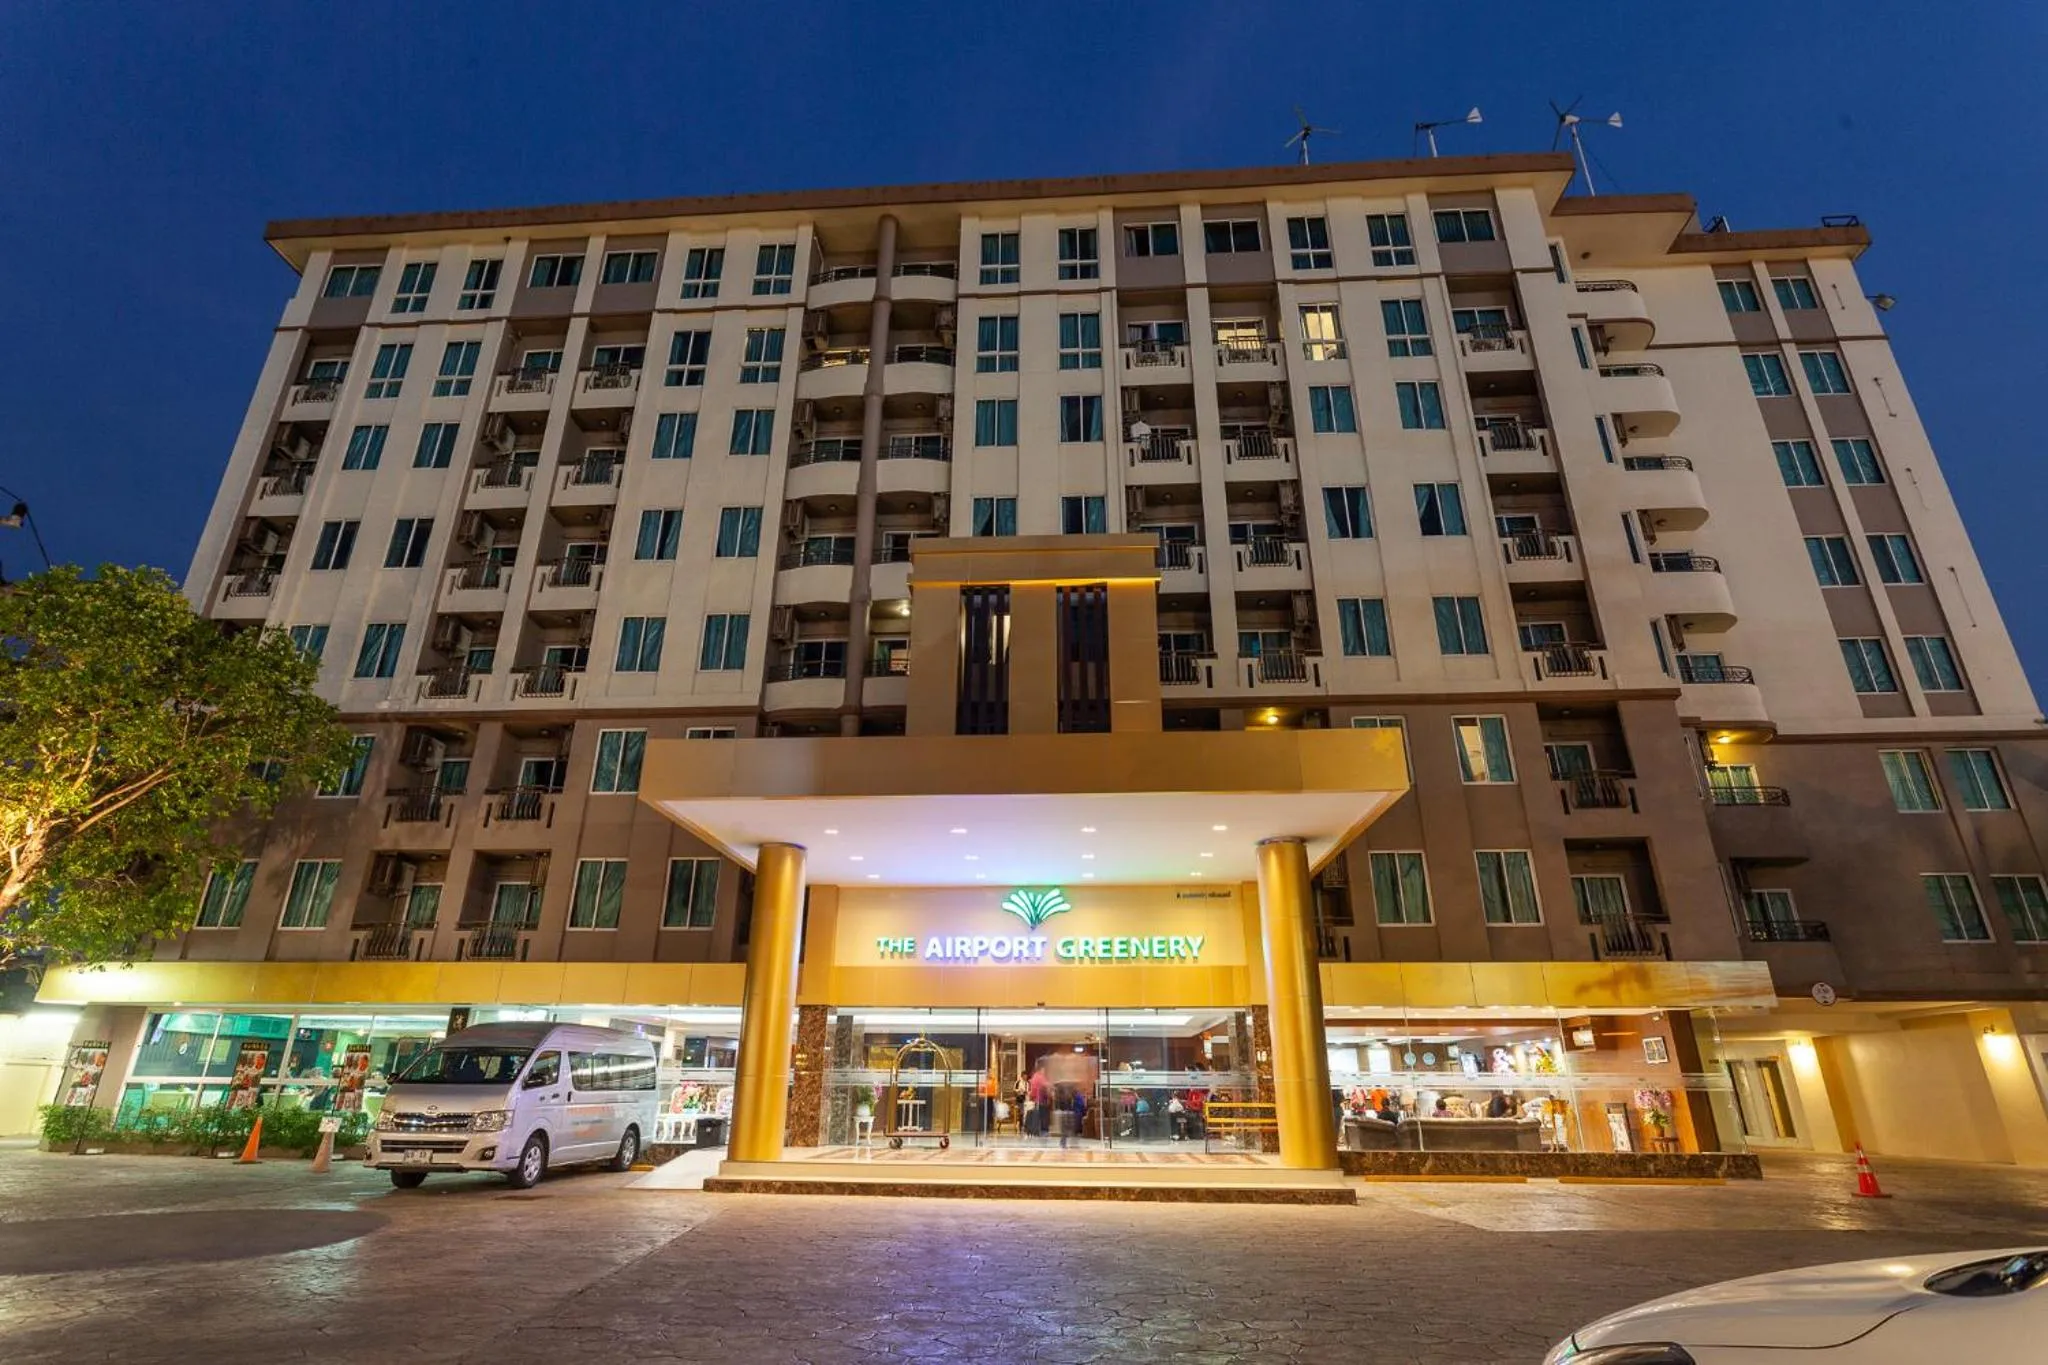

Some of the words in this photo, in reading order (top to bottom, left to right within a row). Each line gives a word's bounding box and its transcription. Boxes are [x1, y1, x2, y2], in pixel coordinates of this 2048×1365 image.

[876, 937, 916, 954] THE
[925, 936, 1047, 959] AIRPORT
[1056, 936, 1203, 959] GREENERY
